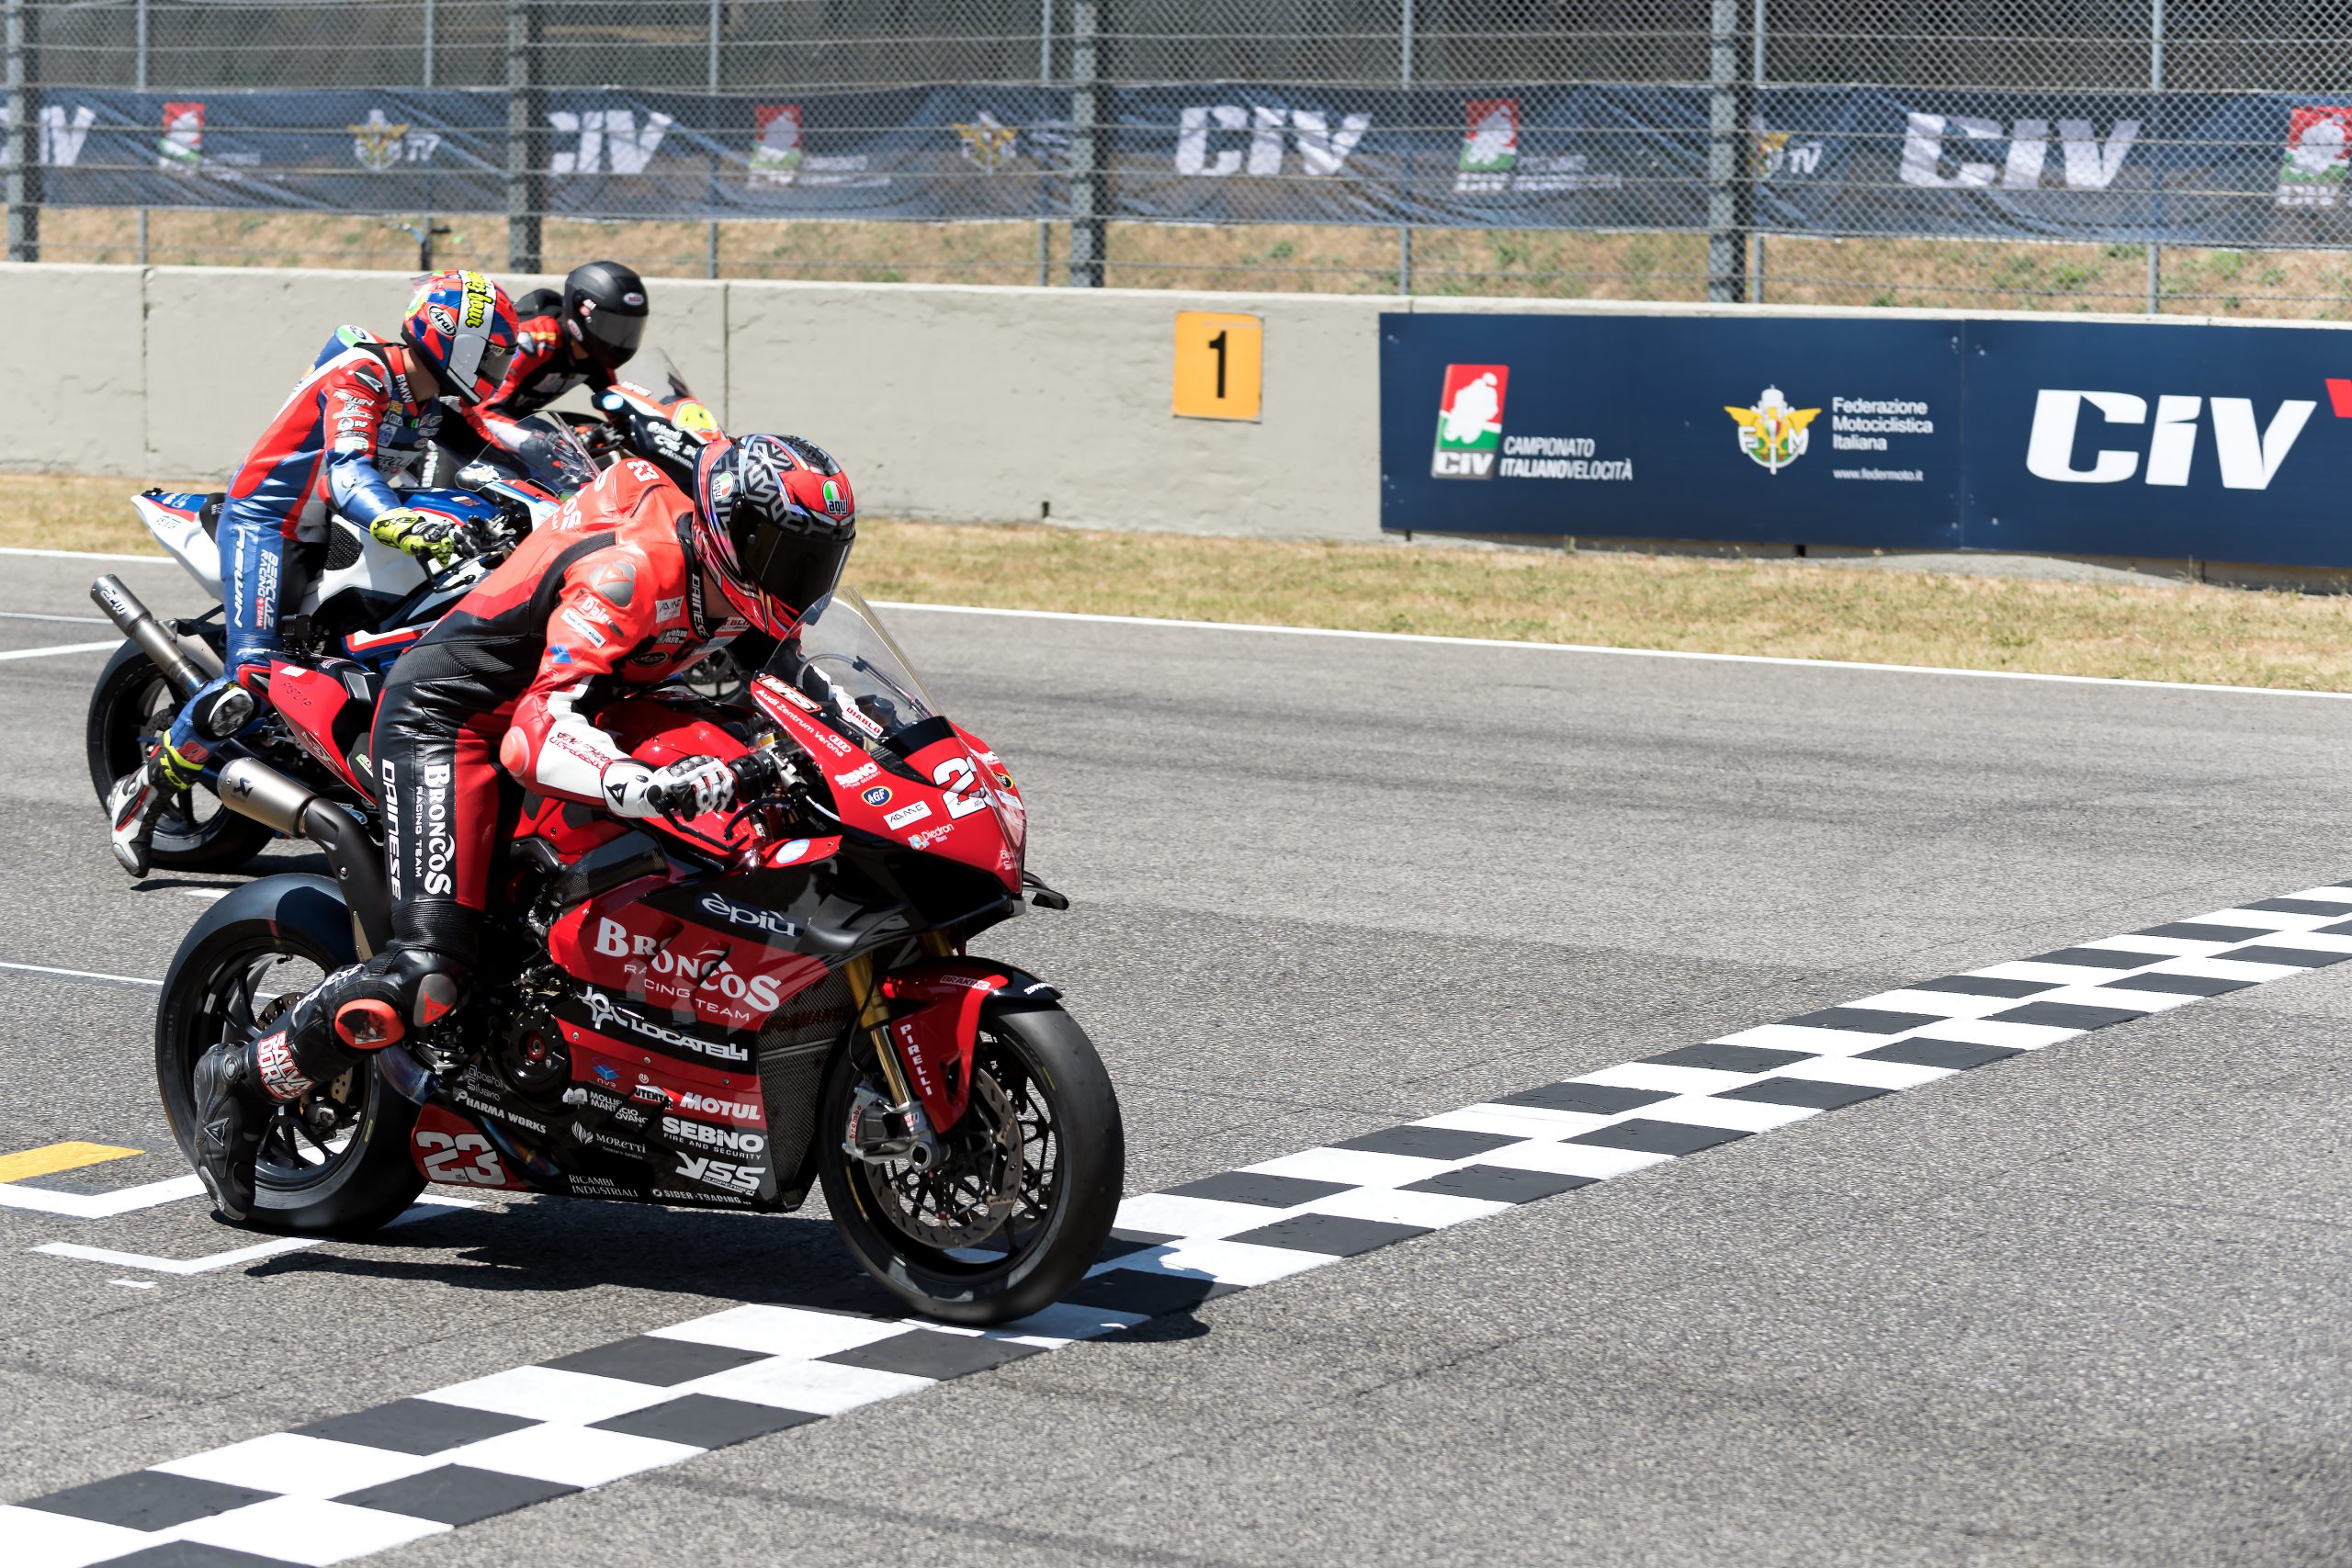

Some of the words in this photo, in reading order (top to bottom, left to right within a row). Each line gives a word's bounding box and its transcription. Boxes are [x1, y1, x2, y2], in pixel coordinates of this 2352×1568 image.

[1900, 113, 2141, 189] CIV
[432, 310, 457, 333] Arai
[1208, 330, 1227, 399] 1
[395, 373, 414, 403] BMW
[1832, 397, 1928, 414] Federazione
[1832, 415, 1934, 434] Motociclistica
[2026, 389, 2318, 490] CIV
[1503, 435, 1595, 457] CAMPIONATO
[1832, 434, 1888, 451] Italiana
[627, 459, 661, 482] 23
[1434, 451, 1495, 475] CIV
[1833, 468, 1924, 482] www.federmoto.it
[257, 549, 268, 597] RACING
[692, 573, 710, 637] DAINESE
[756, 690, 779, 706] Audi
[777, 703, 814, 734] Zentrum
[815, 731, 844, 758] Verona
[846, 706, 881, 734] DIABLO
[415, 785, 424, 835] RACING
[867, 788, 885, 805] AGF
[382, 759, 401, 901] DAINESE
[424, 763, 456, 895] BRONCOS
[921, 823, 955, 841] Diedron
[594, 917, 783, 1012] BRONCOS
[624, 964, 690, 998] RACING
[695, 998, 750, 1021] TEAM
[940, 975, 991, 990] BRAKING
[900, 1023, 933, 1096] PIRELLI
[455, 1089, 504, 1119] PHARMA
[508, 1111, 547, 1134] WORKS
[680, 1091, 761, 1120] MOTUL
[849, 1103, 862, 1139] brembo
[415, 1131, 506, 1185] 23
[664, 1133, 684, 1143] FIRE
[689, 1140, 708, 1151] AND
[713, 1145, 762, 1160] SECURITY
[569, 1174, 615, 1187] RICAMBI
[675, 1150, 766, 1190] YSS
[571, 1183, 638, 1198] INDUSTRIALI
